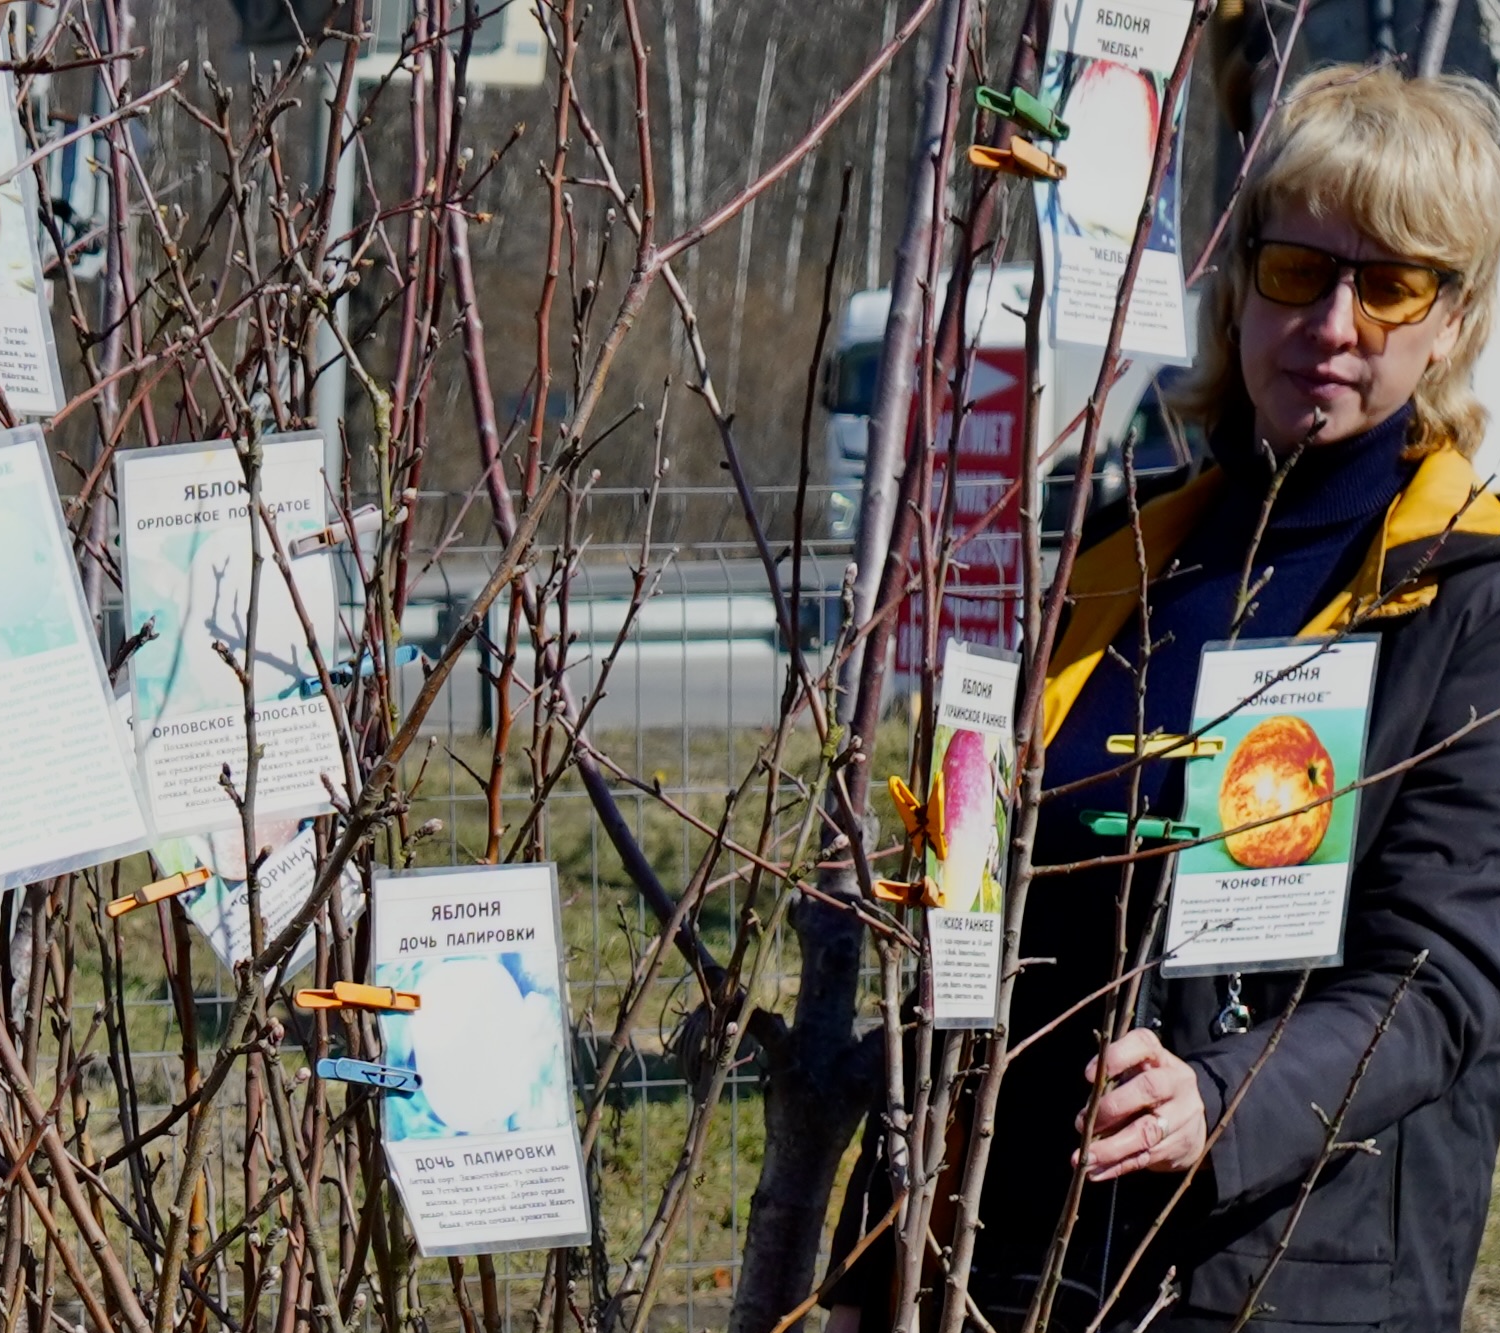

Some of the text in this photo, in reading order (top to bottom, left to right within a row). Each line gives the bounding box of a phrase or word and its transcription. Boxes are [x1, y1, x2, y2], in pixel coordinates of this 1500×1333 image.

[1096, 7, 1151, 35] ЯБЛОНЯ
[1097, 37, 1144, 59] "МЕЛБА"
[137, 509, 220, 530] ОРЛОВСКОЕ
[960, 677, 992, 699] ЯБЛОНЯ
[152, 701, 327, 738] ОРЛОВСКОЕ ОЛОСАТОЕ
[1214, 872, 1311, 890] "КОНФЕТНОЕ"
[431, 900, 502, 921] ЯБЛОНЯ
[398, 927, 536, 954] ДОЧЬ ПАПИРОВКИ
[414, 1143, 557, 1172] ДОЧЬ ПАПИРОВКИ
